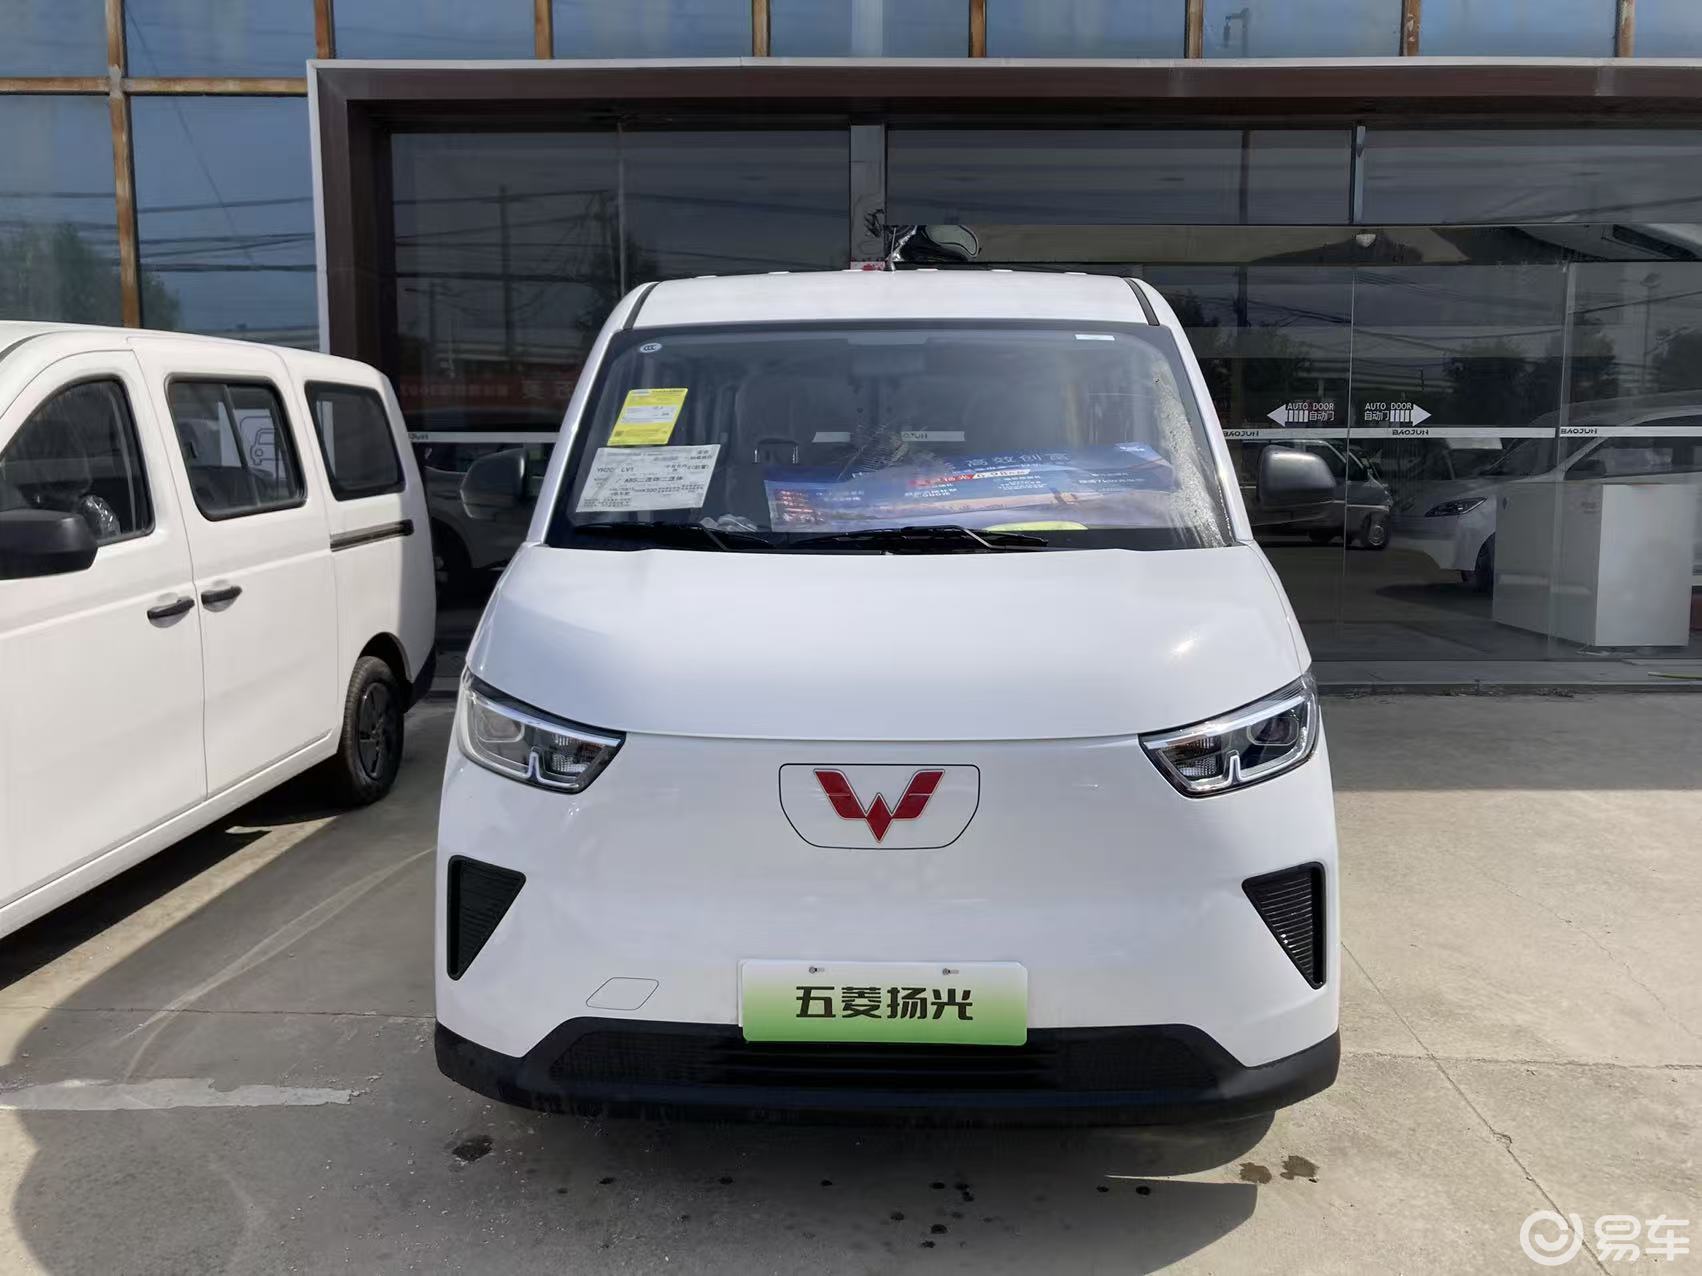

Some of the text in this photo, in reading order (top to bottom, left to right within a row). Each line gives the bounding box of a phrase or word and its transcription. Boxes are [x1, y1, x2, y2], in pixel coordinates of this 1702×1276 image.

[1287, 402, 1335, 410] AUTO DOOR
[1364, 402, 1412, 410] AUTO DOOR
[1309, 411, 1335, 421] 自动门
[1364, 411, 1389, 421] 自动门
[796, 985, 974, 1021] 五菱扬光
